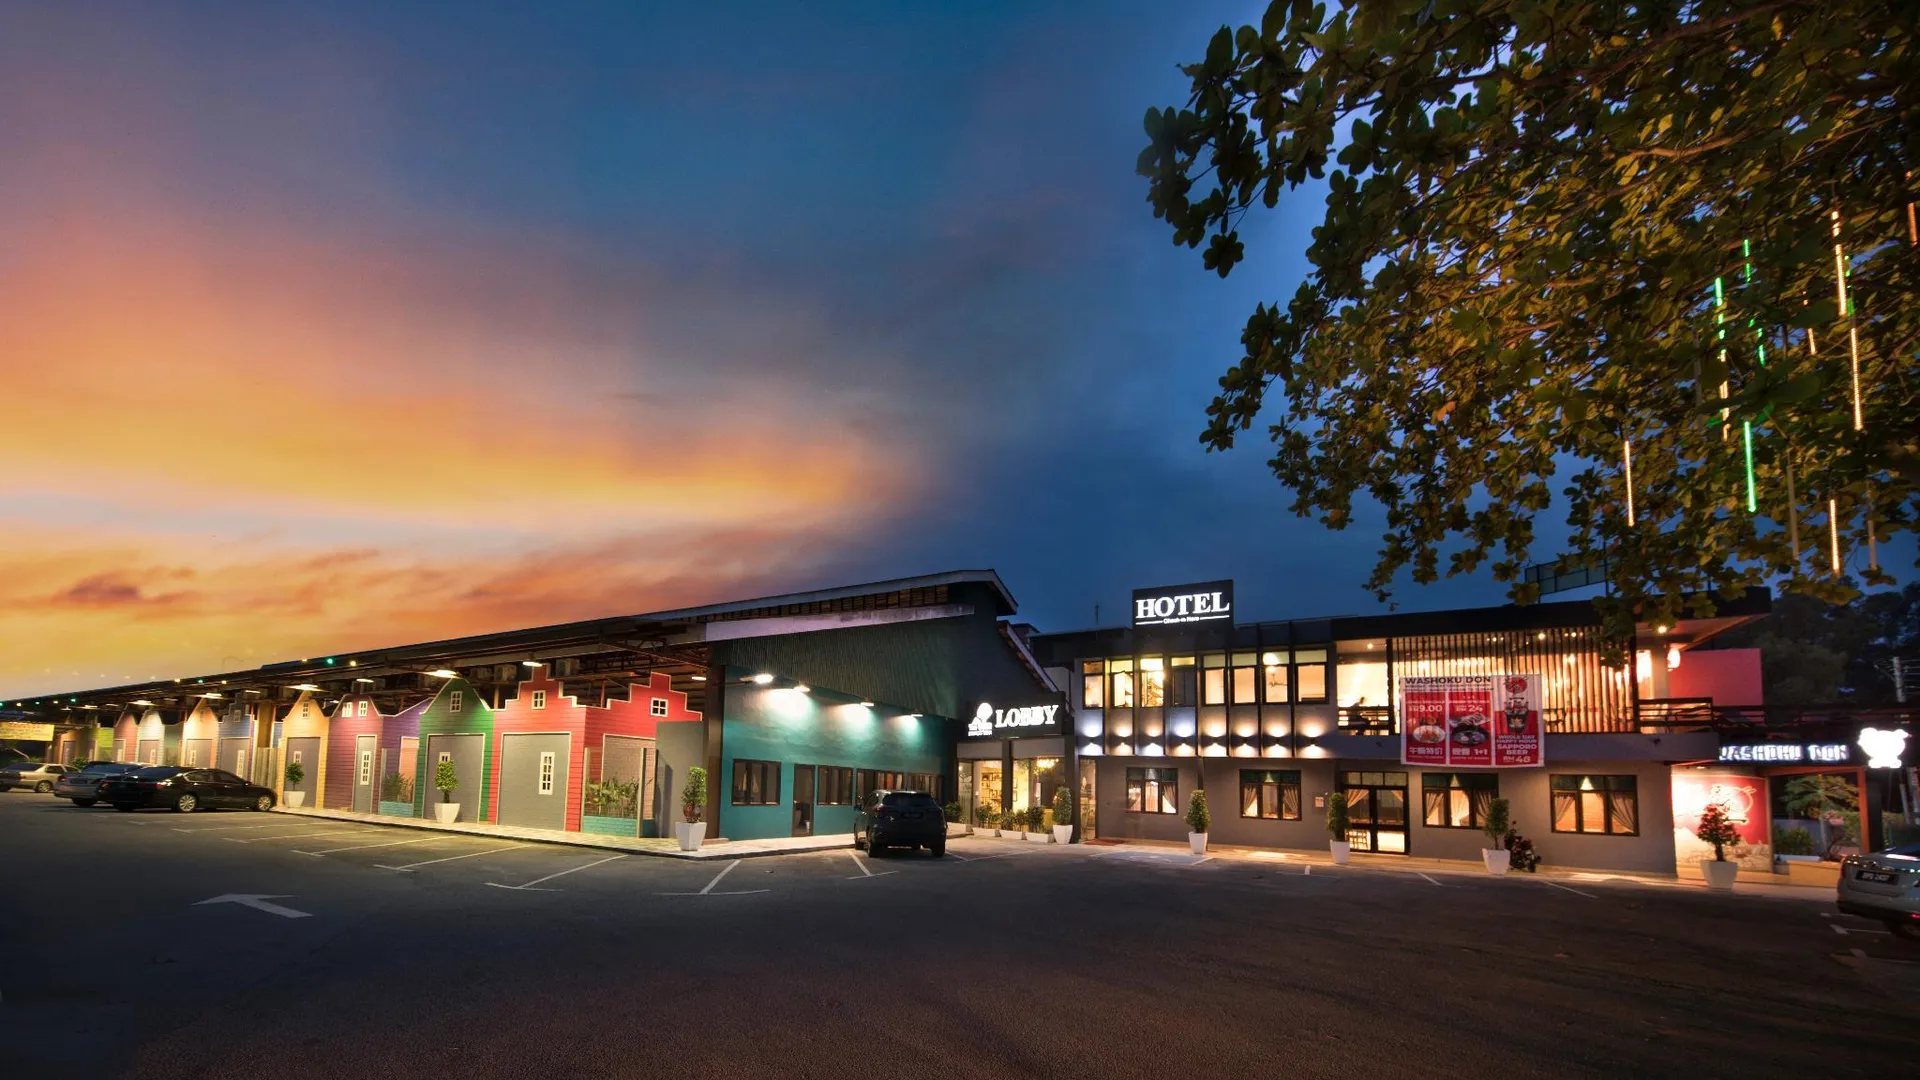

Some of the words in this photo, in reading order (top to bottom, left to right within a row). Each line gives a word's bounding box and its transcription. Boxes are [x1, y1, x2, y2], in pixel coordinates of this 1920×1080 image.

[1135, 592, 1230, 619] HOTEL
[1405, 676, 1462, 685] WASHOKU
[1465, 676, 1491, 684] DON
[994, 705, 1059, 728] LOBBY
